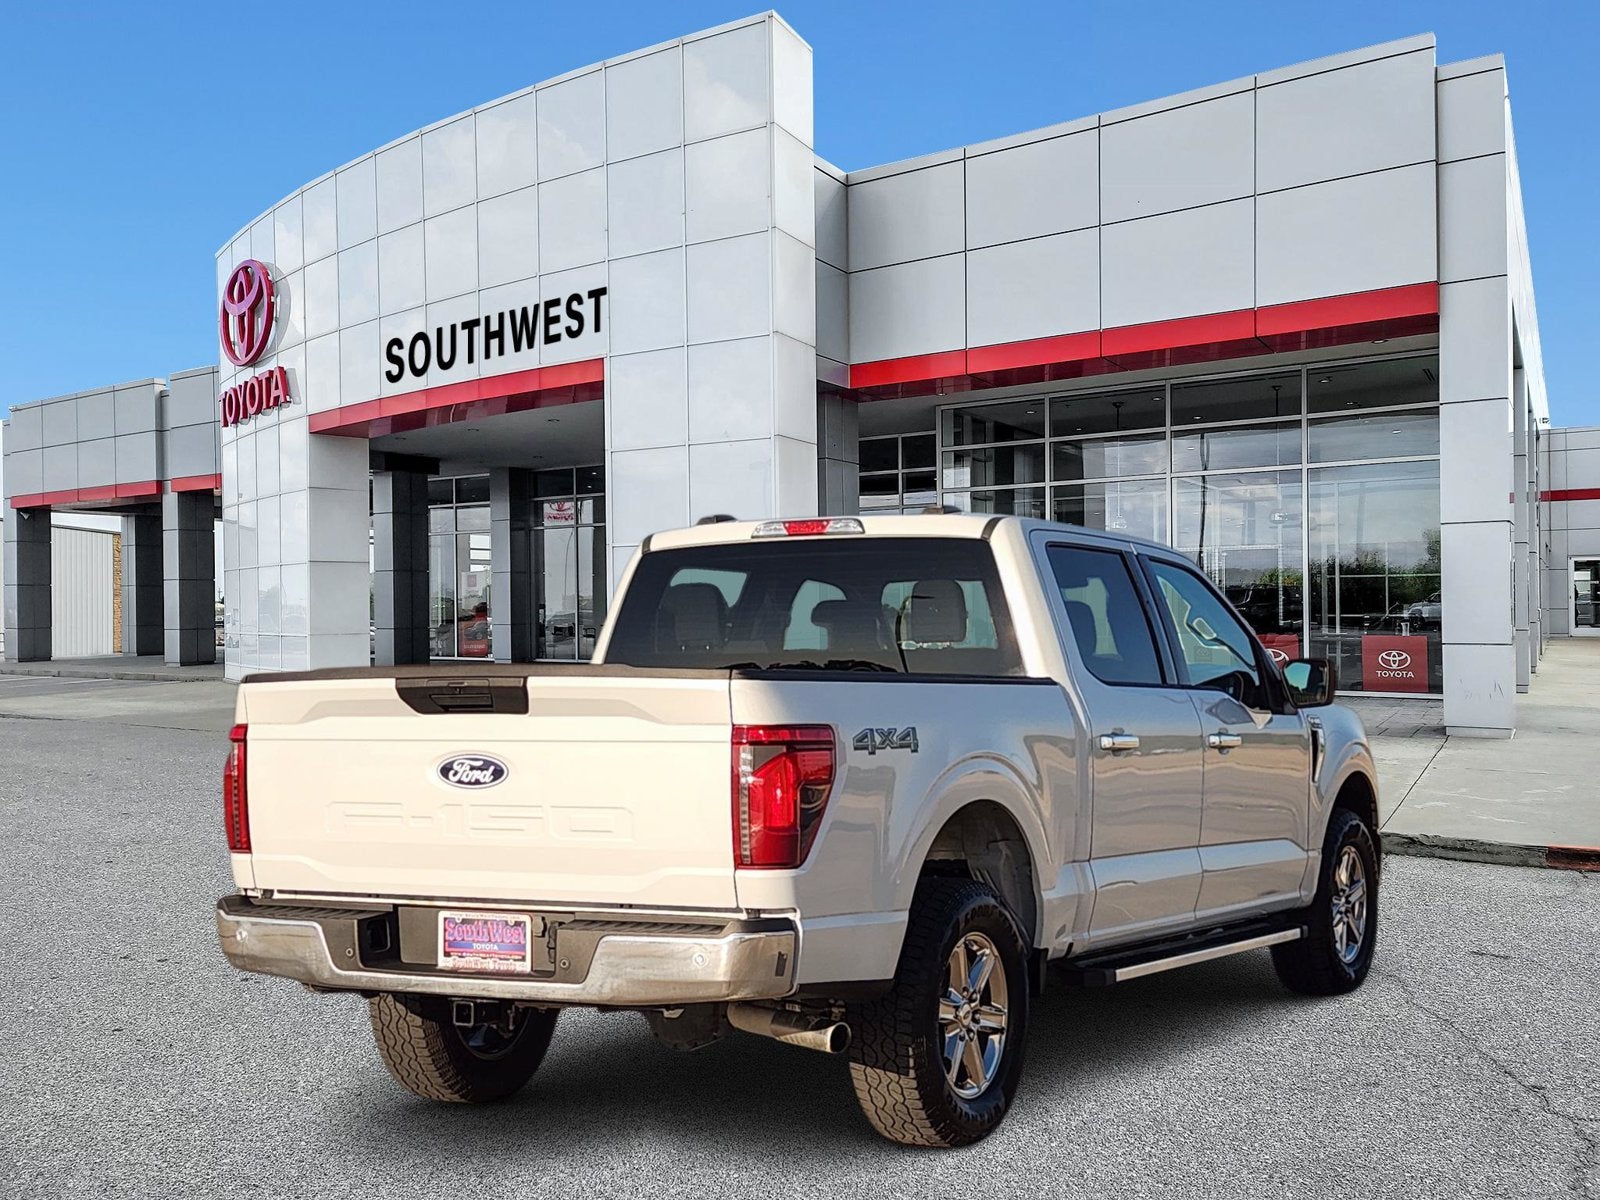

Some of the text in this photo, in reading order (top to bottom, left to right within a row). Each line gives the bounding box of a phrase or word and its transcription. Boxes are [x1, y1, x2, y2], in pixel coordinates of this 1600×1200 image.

[385, 286, 607, 384] SOUTHWEST
[218, 366, 291, 427] TOYOTA
[1375, 670, 1415, 679] TOYOTA
[448, 759, 495, 783] Ford
[472, 942, 499, 951] TOYOTA
